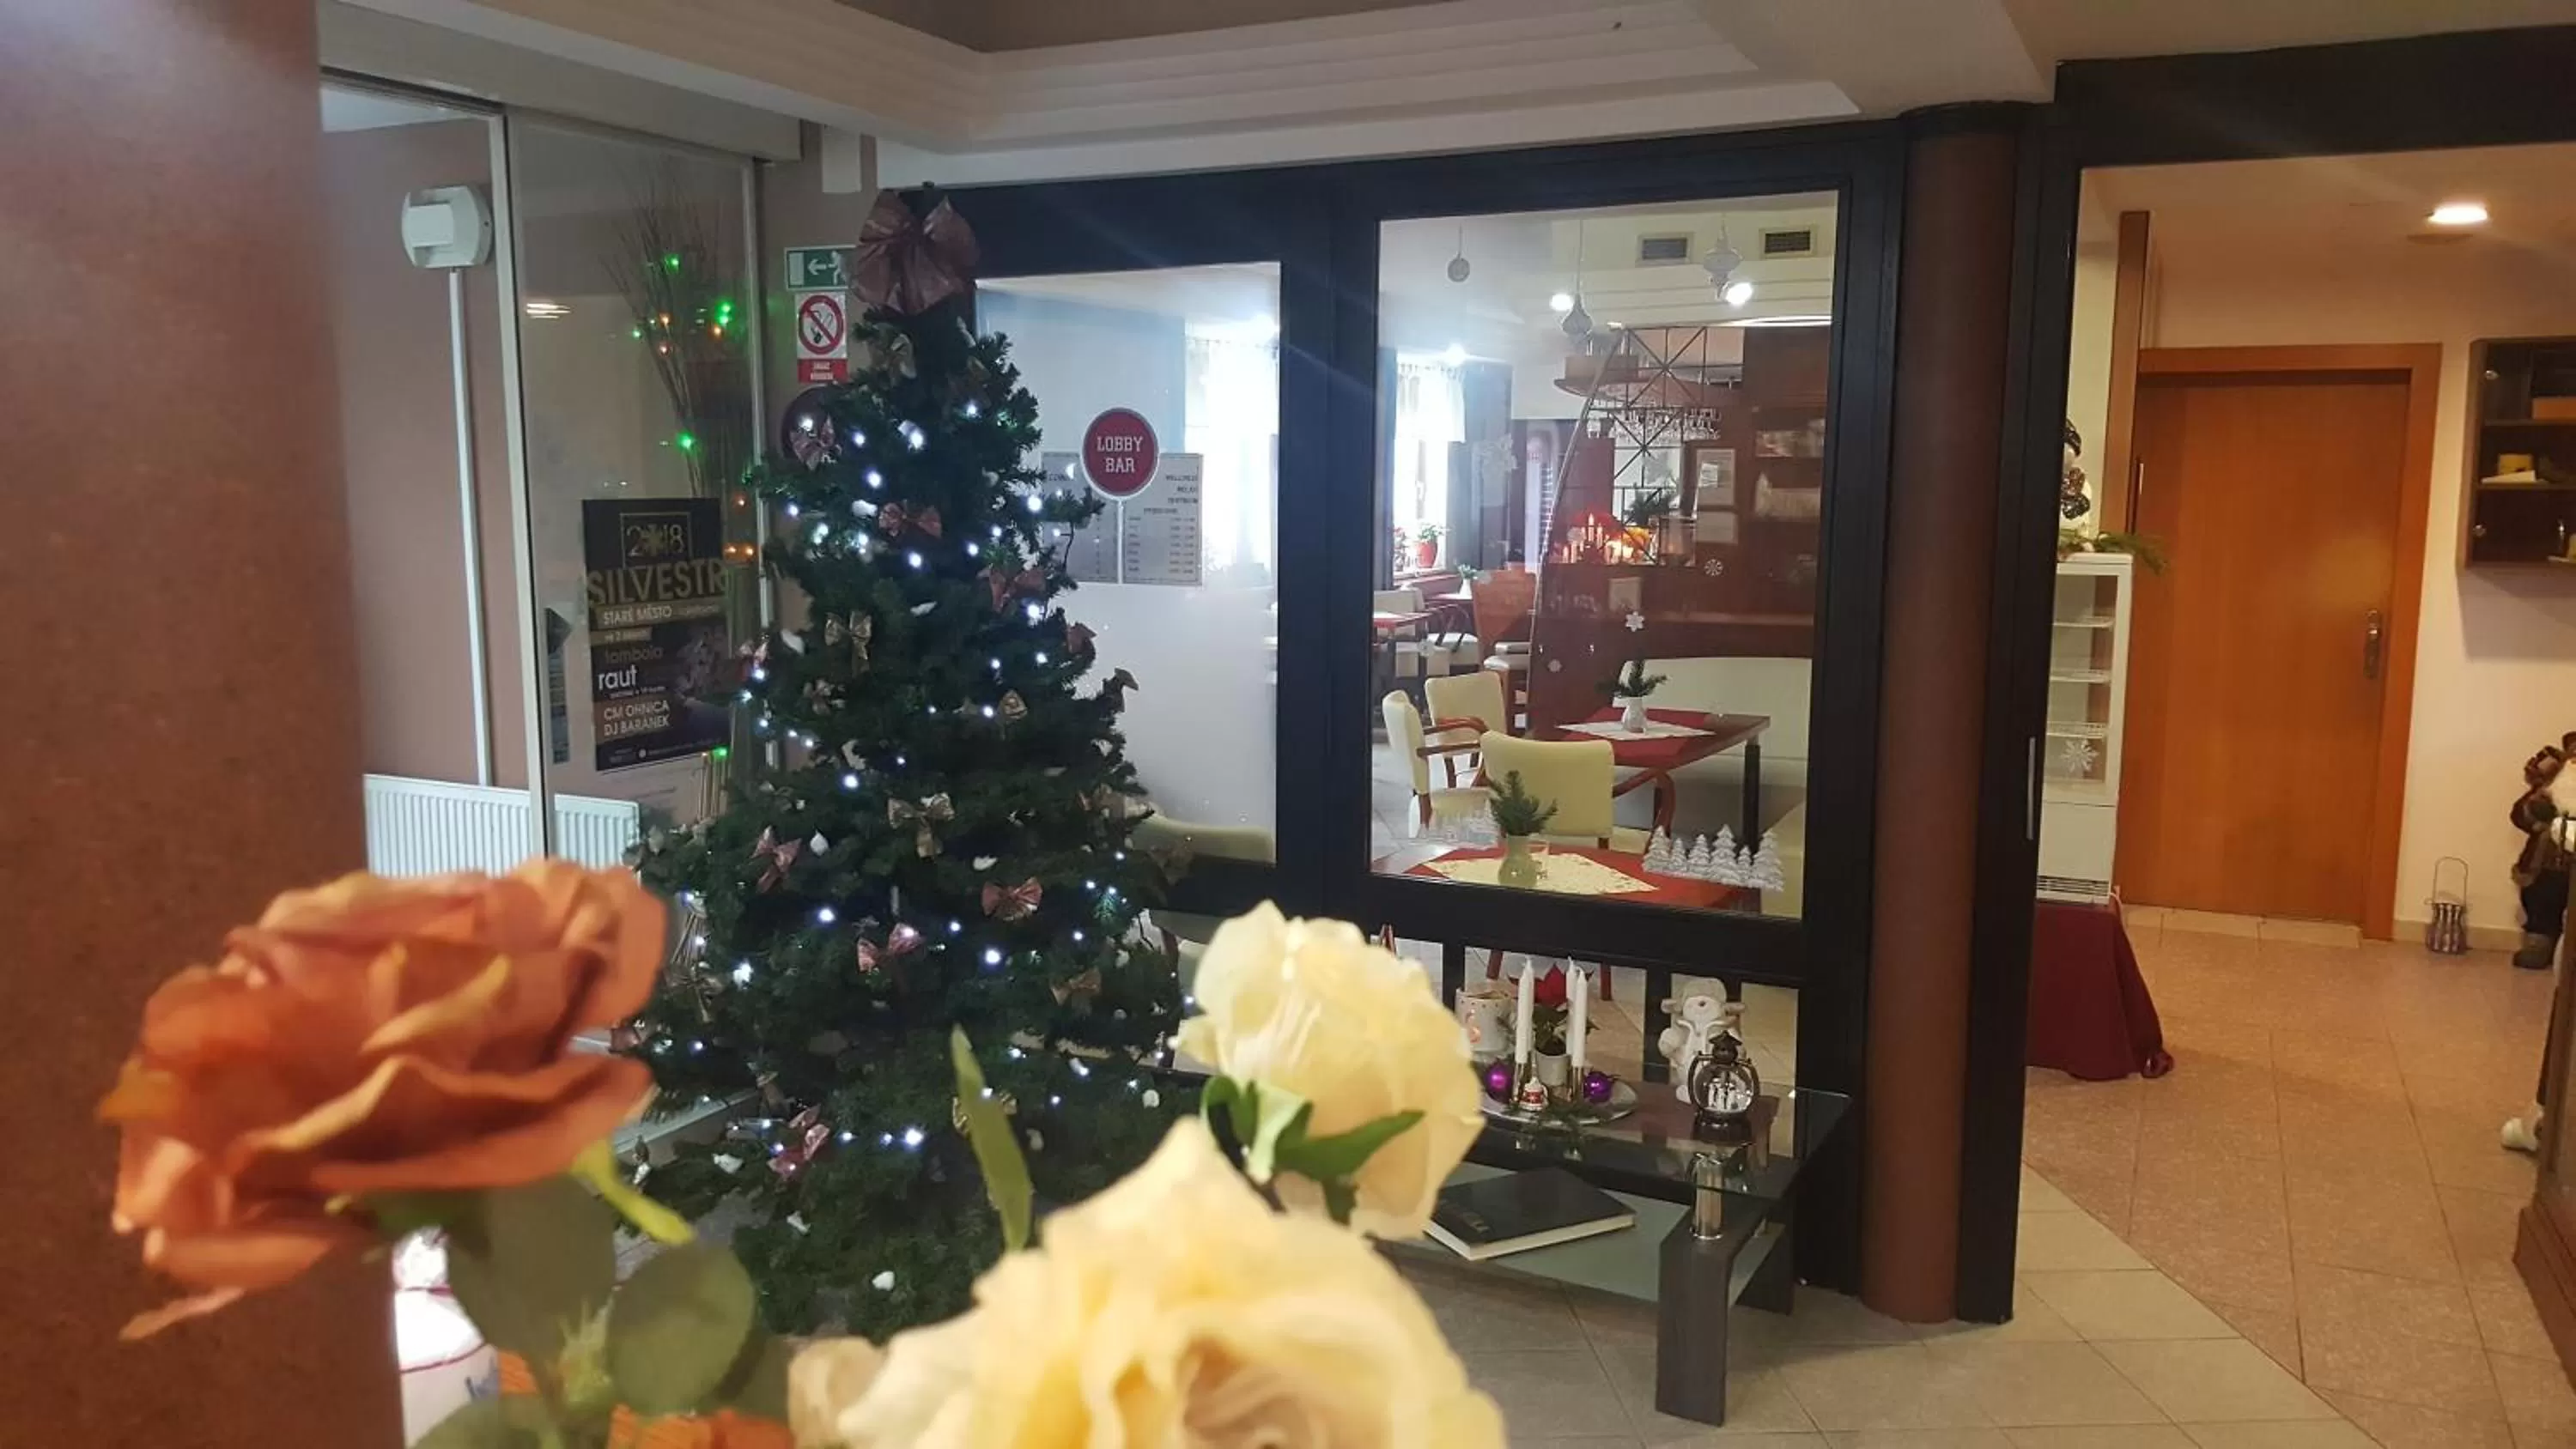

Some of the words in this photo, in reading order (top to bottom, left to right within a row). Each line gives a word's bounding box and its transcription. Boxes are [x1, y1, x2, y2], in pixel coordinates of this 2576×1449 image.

[1096, 435, 1145, 452] LOBBY
[1105, 457, 1135, 473] BAR
[586, 559, 728, 604] SILVESTR
[598, 664, 638, 690] raut
[604, 722, 618, 737] DJ
